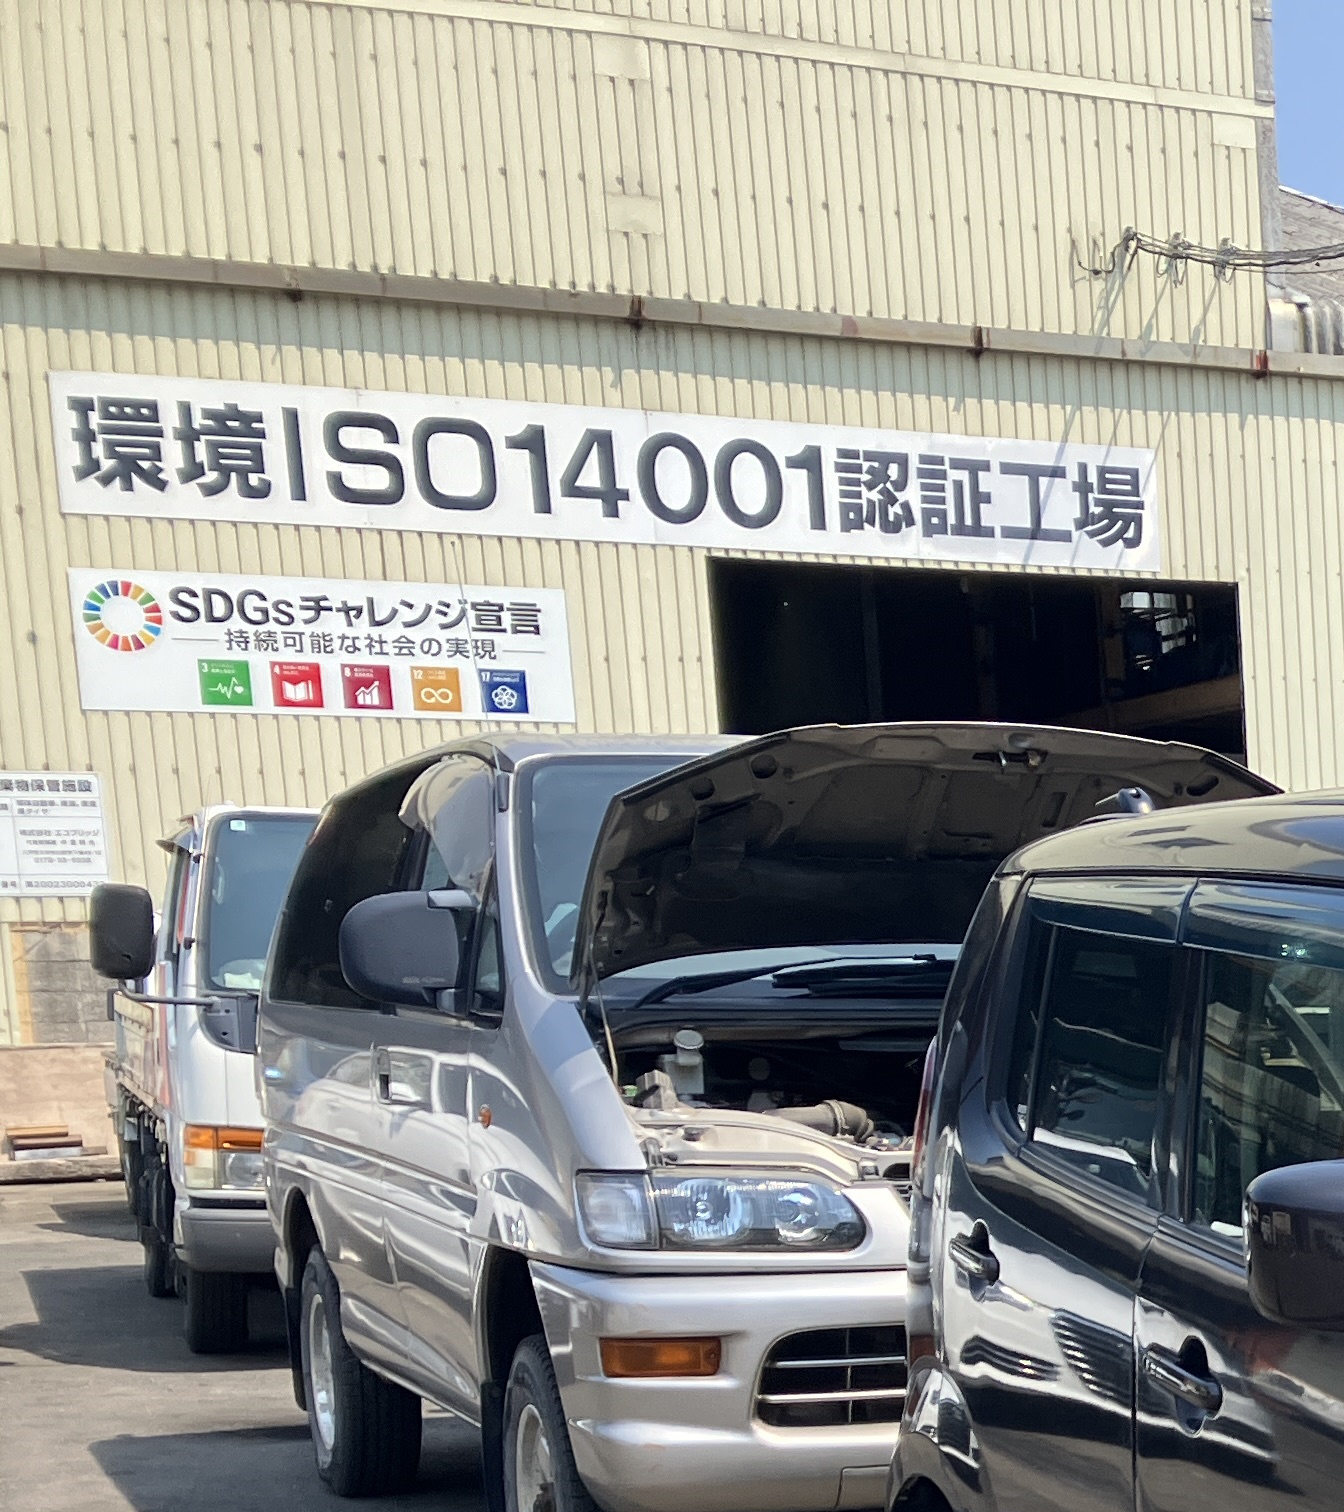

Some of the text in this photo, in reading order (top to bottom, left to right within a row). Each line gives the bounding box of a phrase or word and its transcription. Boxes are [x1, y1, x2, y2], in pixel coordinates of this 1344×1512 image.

[66, 394, 1146, 550] 環境ISO14001認証工場
[168, 585, 542, 636] SDGsチャレンジ宣言
[224, 628, 498, 660] 持続可能な社会の実現
[202, 663, 208, 673] 3
[273, 665, 280, 674] 4
[413, 669, 423, 680] 12
[481, 672, 490, 682] 17
